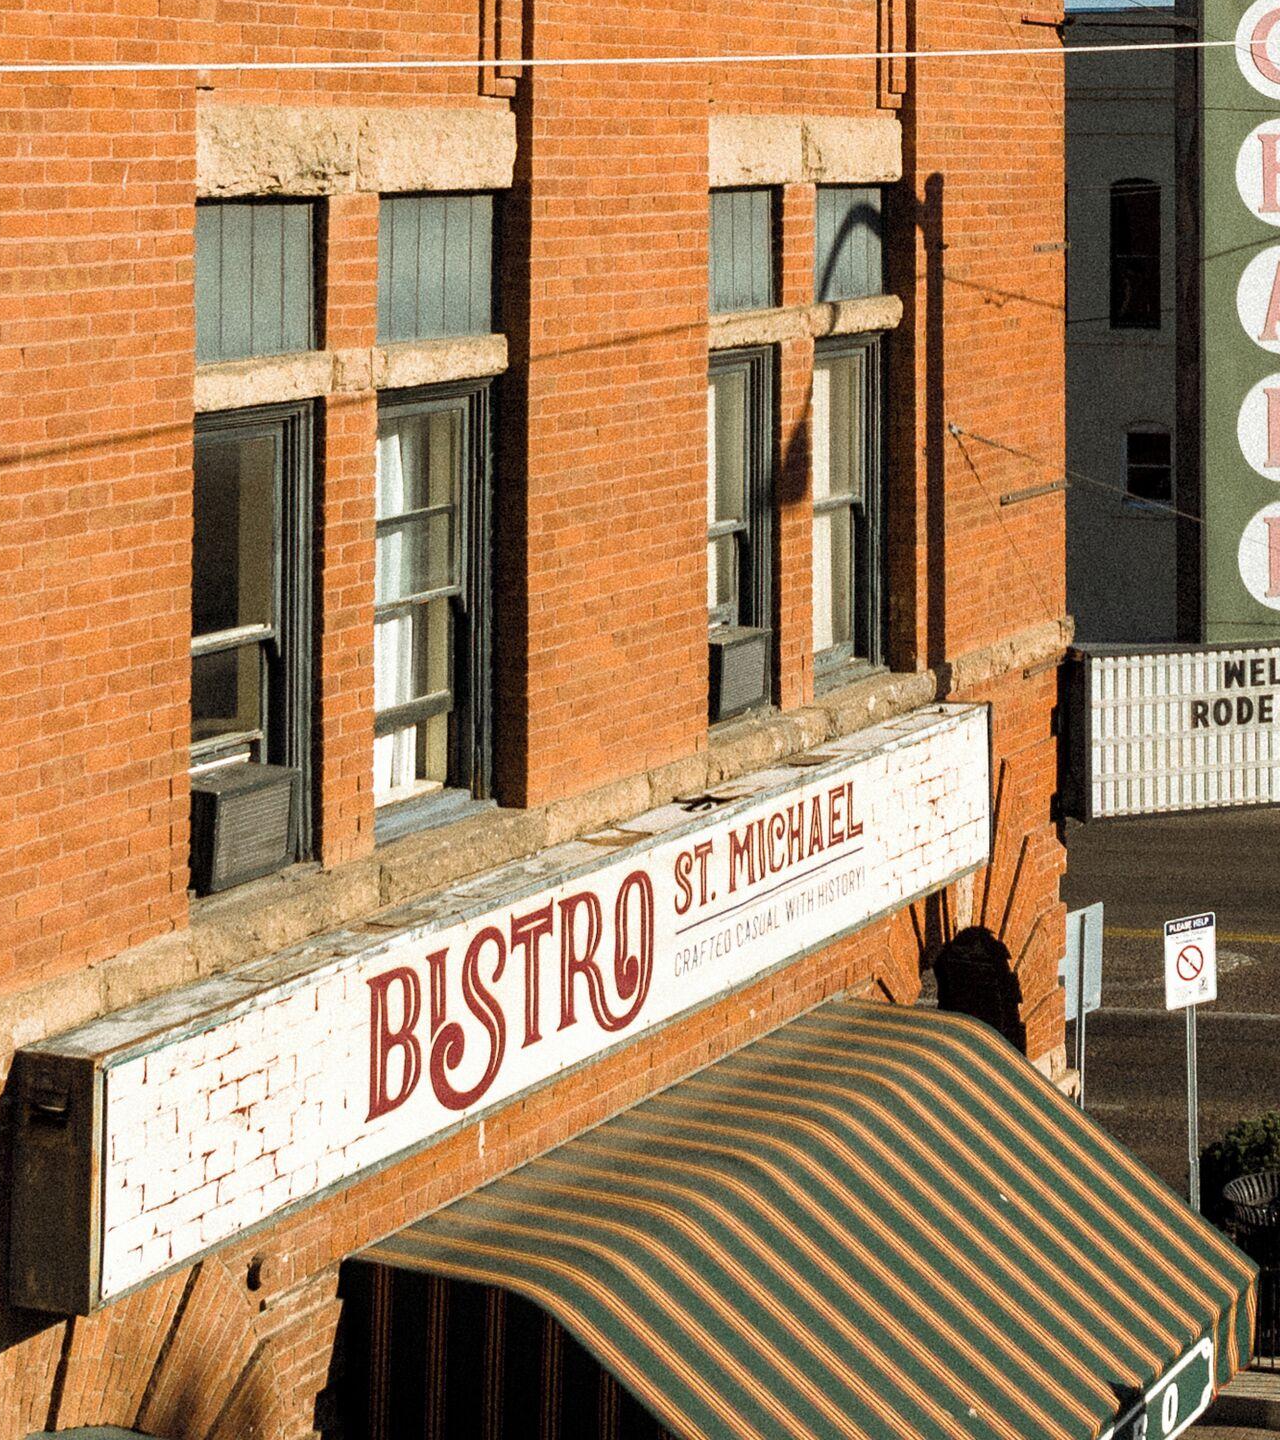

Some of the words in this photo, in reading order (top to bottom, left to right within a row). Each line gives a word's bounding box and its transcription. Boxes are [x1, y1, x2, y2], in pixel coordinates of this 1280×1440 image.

[674, 837, 717, 916] ST.
[728, 780, 864, 894] MICHAEL
[674, 927, 732, 977] CRAFTED
[736, 905, 781, 948] CASUAL
[785, 886, 814, 923] WITH
[817, 864, 866, 909] HISTORY!
[365, 870, 654, 1123] BISTRO
